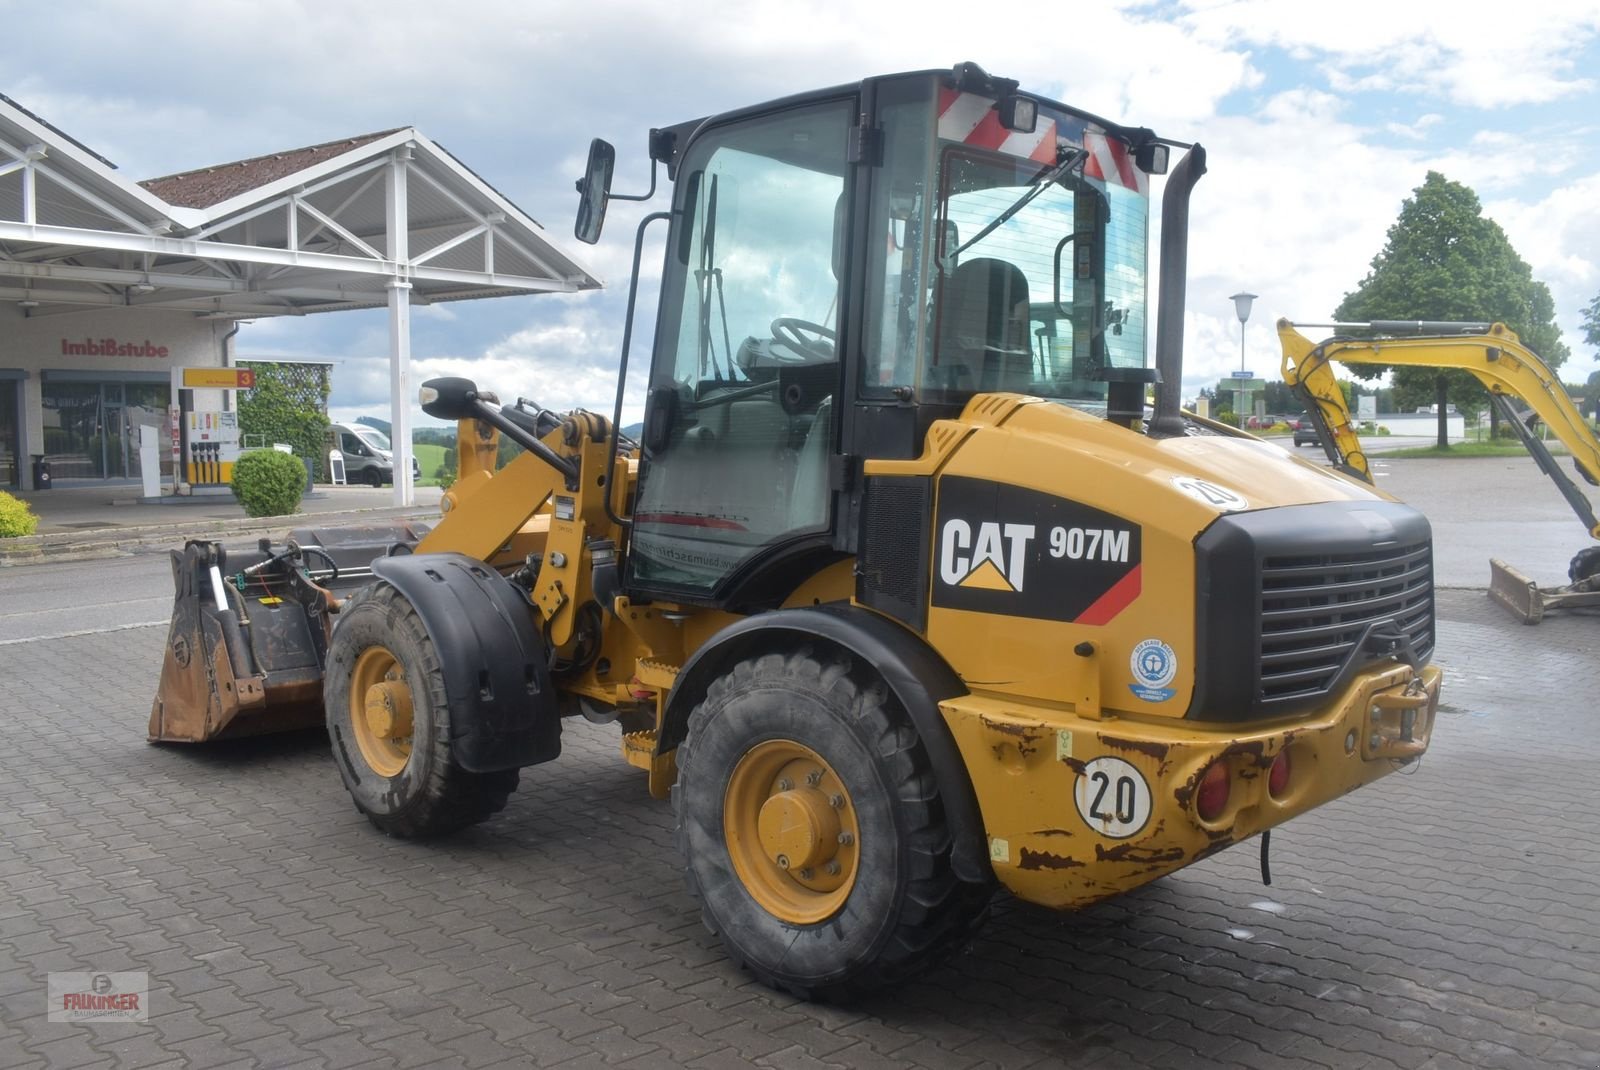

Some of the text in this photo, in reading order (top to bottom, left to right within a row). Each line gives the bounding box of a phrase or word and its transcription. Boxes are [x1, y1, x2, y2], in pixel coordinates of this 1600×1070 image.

[62, 338, 168, 358] Imbißstube
[241, 372, 250, 385] 3
[1180, 481, 1239, 504] 20
[940, 519, 1130, 592] CAT 907M
[1090, 771, 1135, 824] 20
